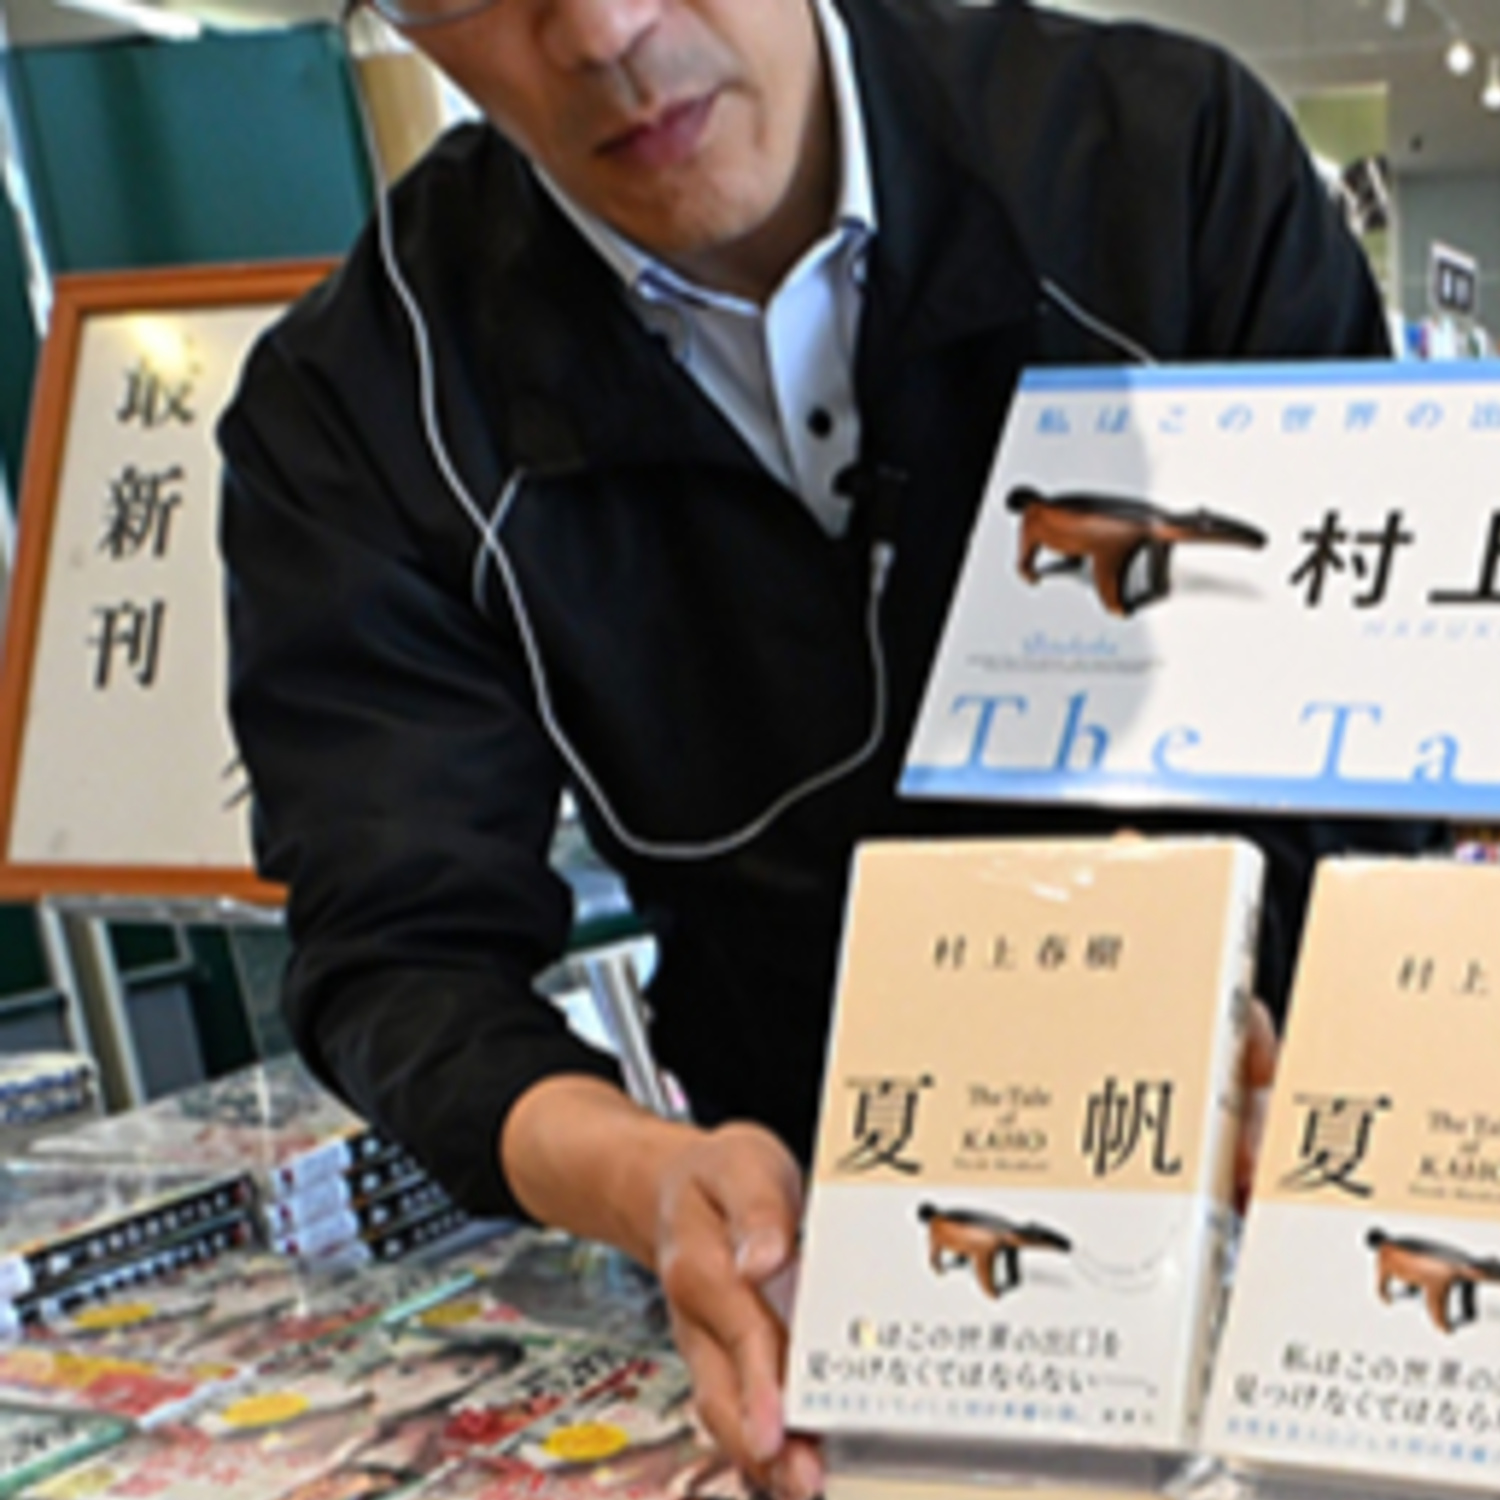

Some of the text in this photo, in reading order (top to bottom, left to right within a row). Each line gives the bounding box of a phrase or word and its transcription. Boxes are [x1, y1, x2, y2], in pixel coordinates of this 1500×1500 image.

[952, 690, 1201, 780] The
[934, 934, 1122, 971] 村上春樹
[836, 1073, 1184, 1177] 夏 帆
[1277, 1093, 1392, 1198] 夏
